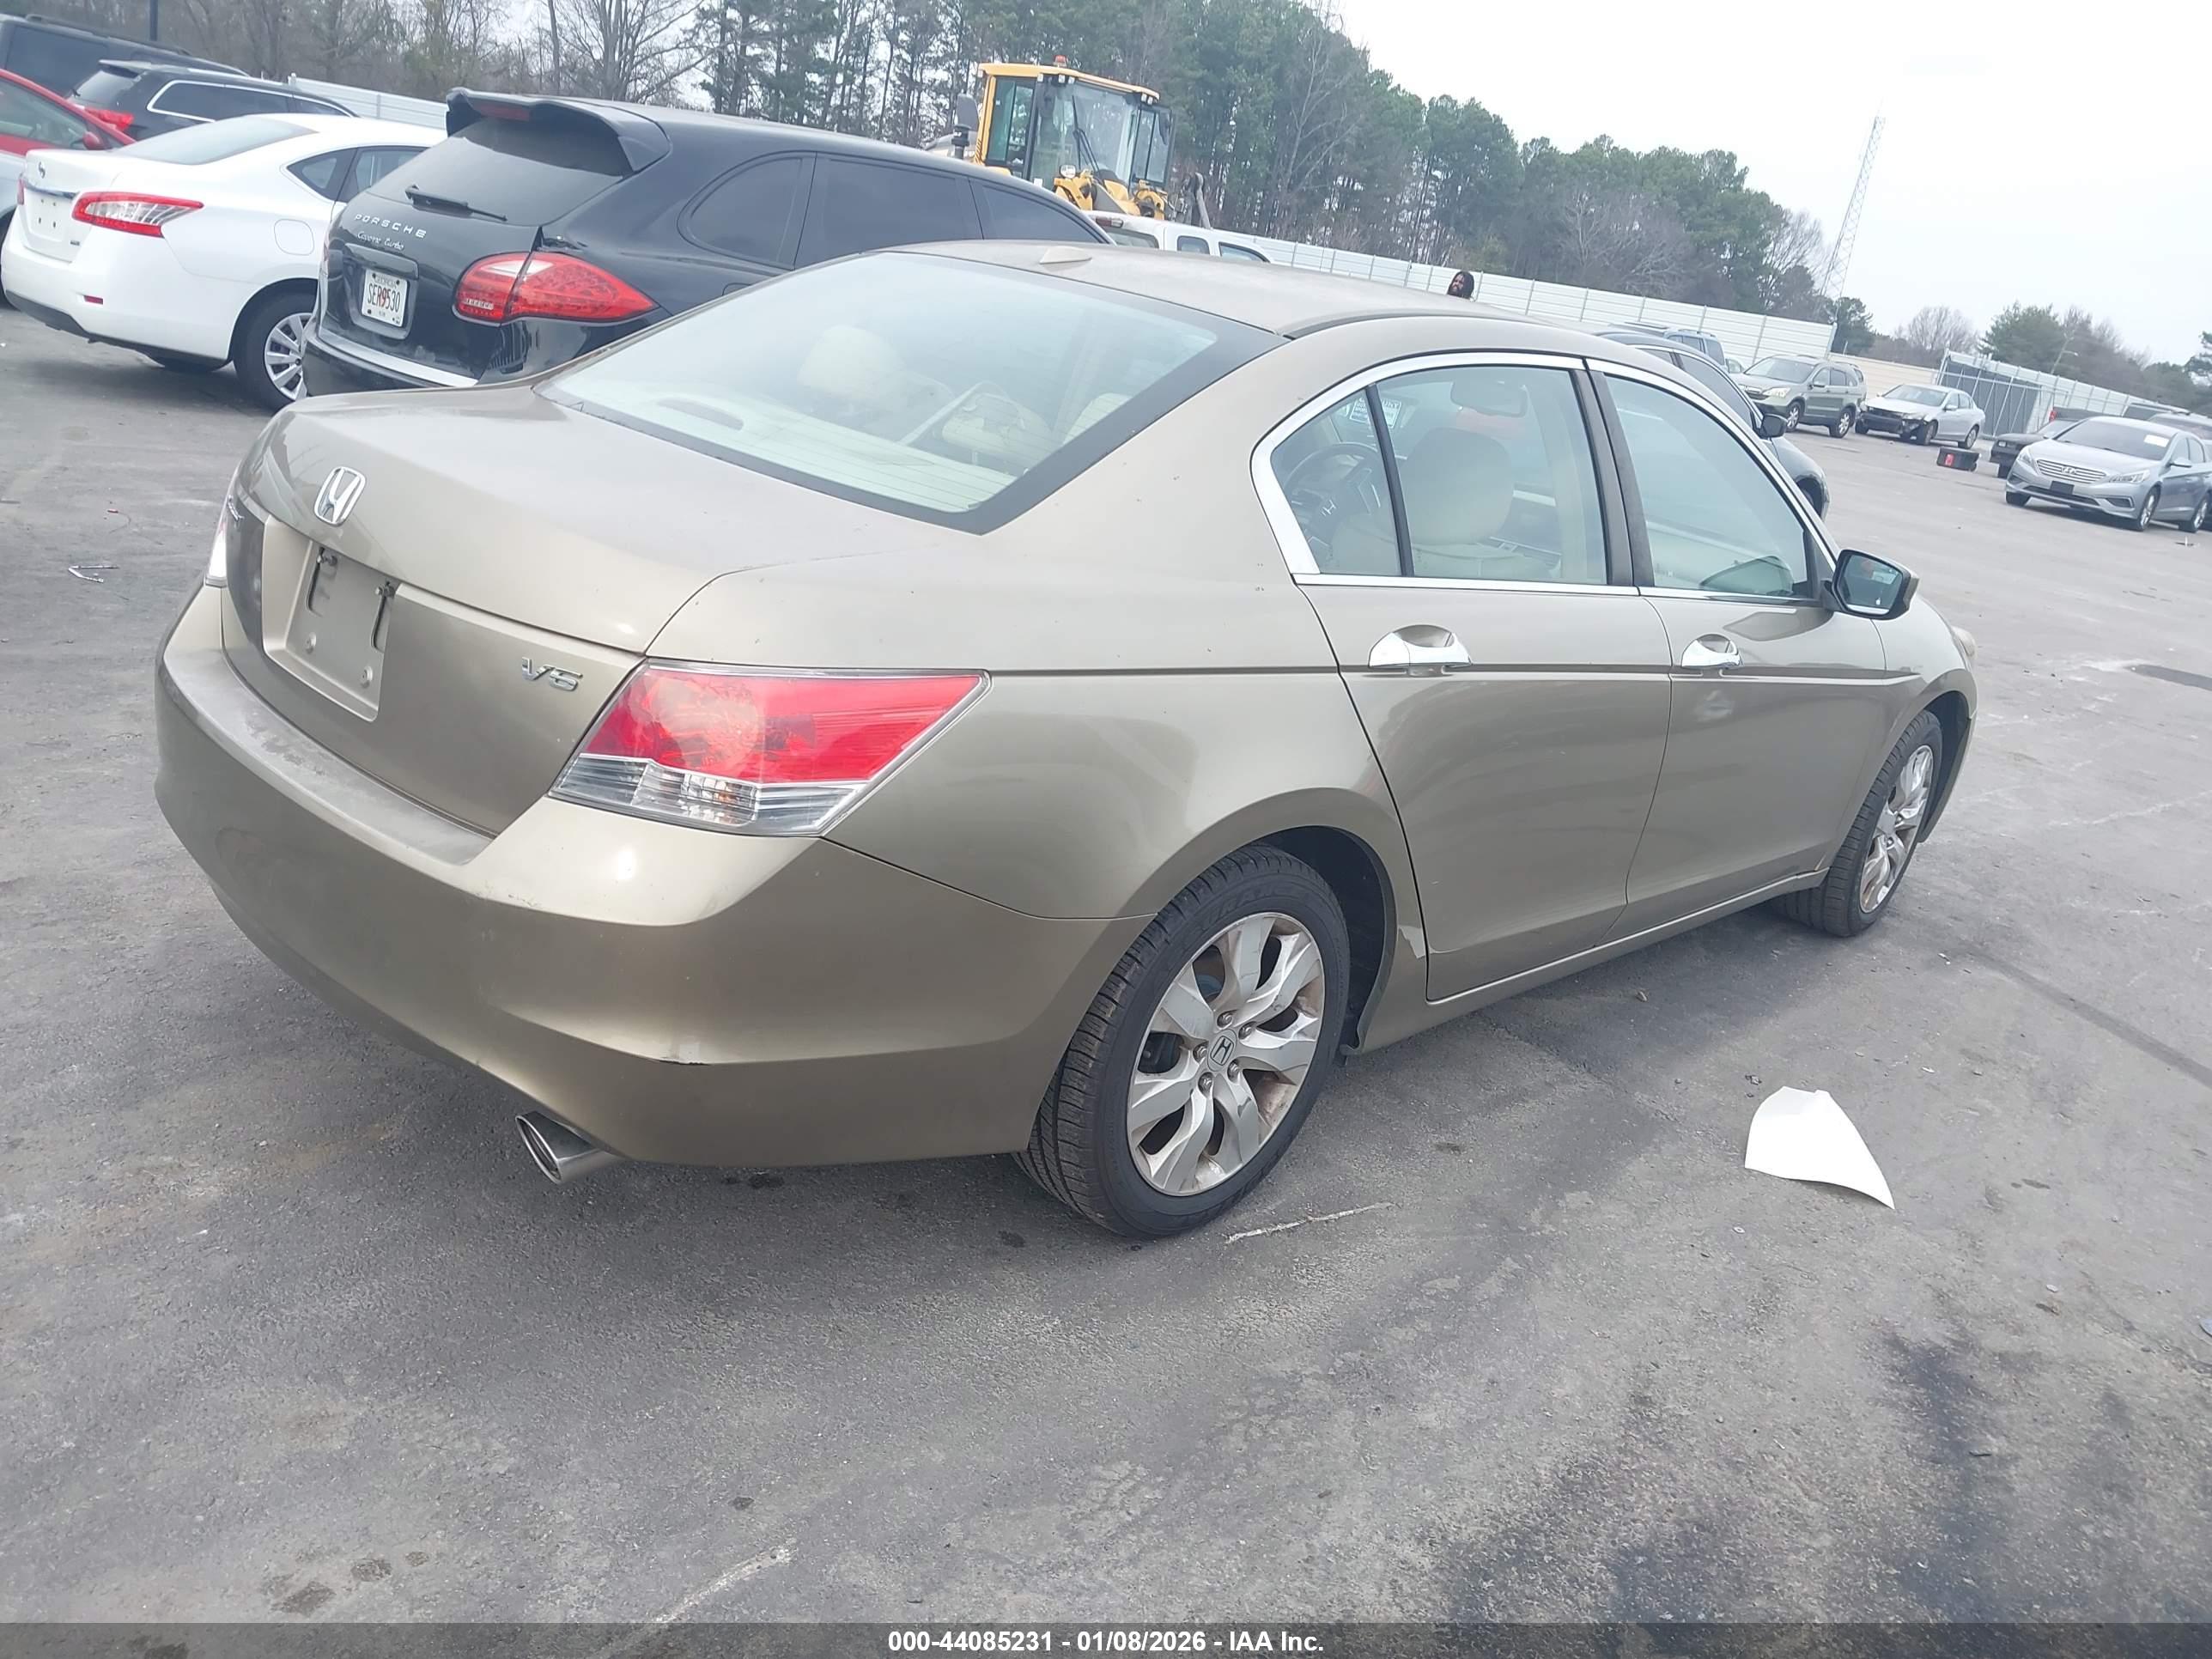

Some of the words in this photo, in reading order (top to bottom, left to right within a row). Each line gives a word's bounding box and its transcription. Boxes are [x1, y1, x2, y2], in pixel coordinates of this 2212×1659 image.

[355, 214, 426, 238] PORSCHE
[368, 283, 401, 313] SER9530
[521, 656, 583, 692] V6
